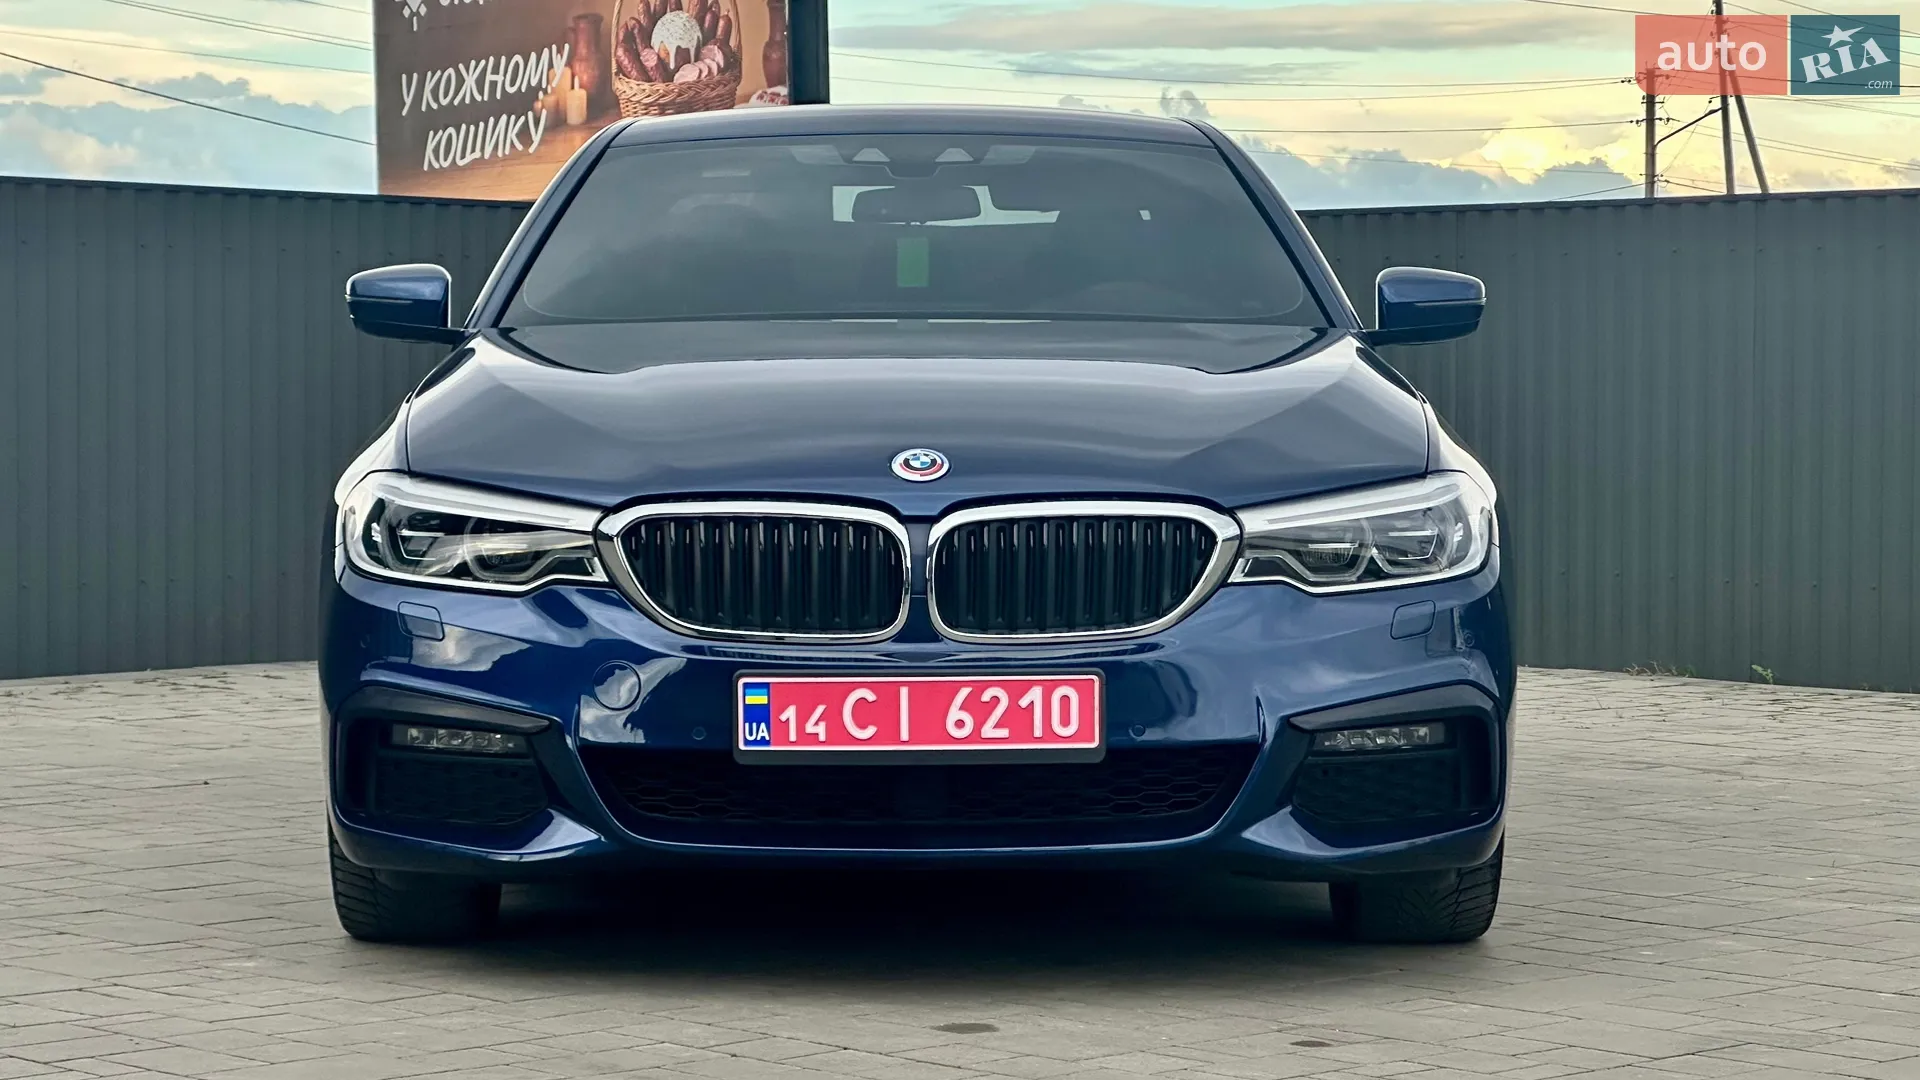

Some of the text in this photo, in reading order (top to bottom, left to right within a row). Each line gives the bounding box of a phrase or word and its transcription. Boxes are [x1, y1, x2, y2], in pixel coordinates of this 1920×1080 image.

[401, 43, 570, 116] У КОЖНОМУ
[423, 108, 548, 171] КОШИКУ
[744, 722, 770, 741] UA
[778, 704, 828, 743] 14
[944, 684, 1080, 739] 6210
